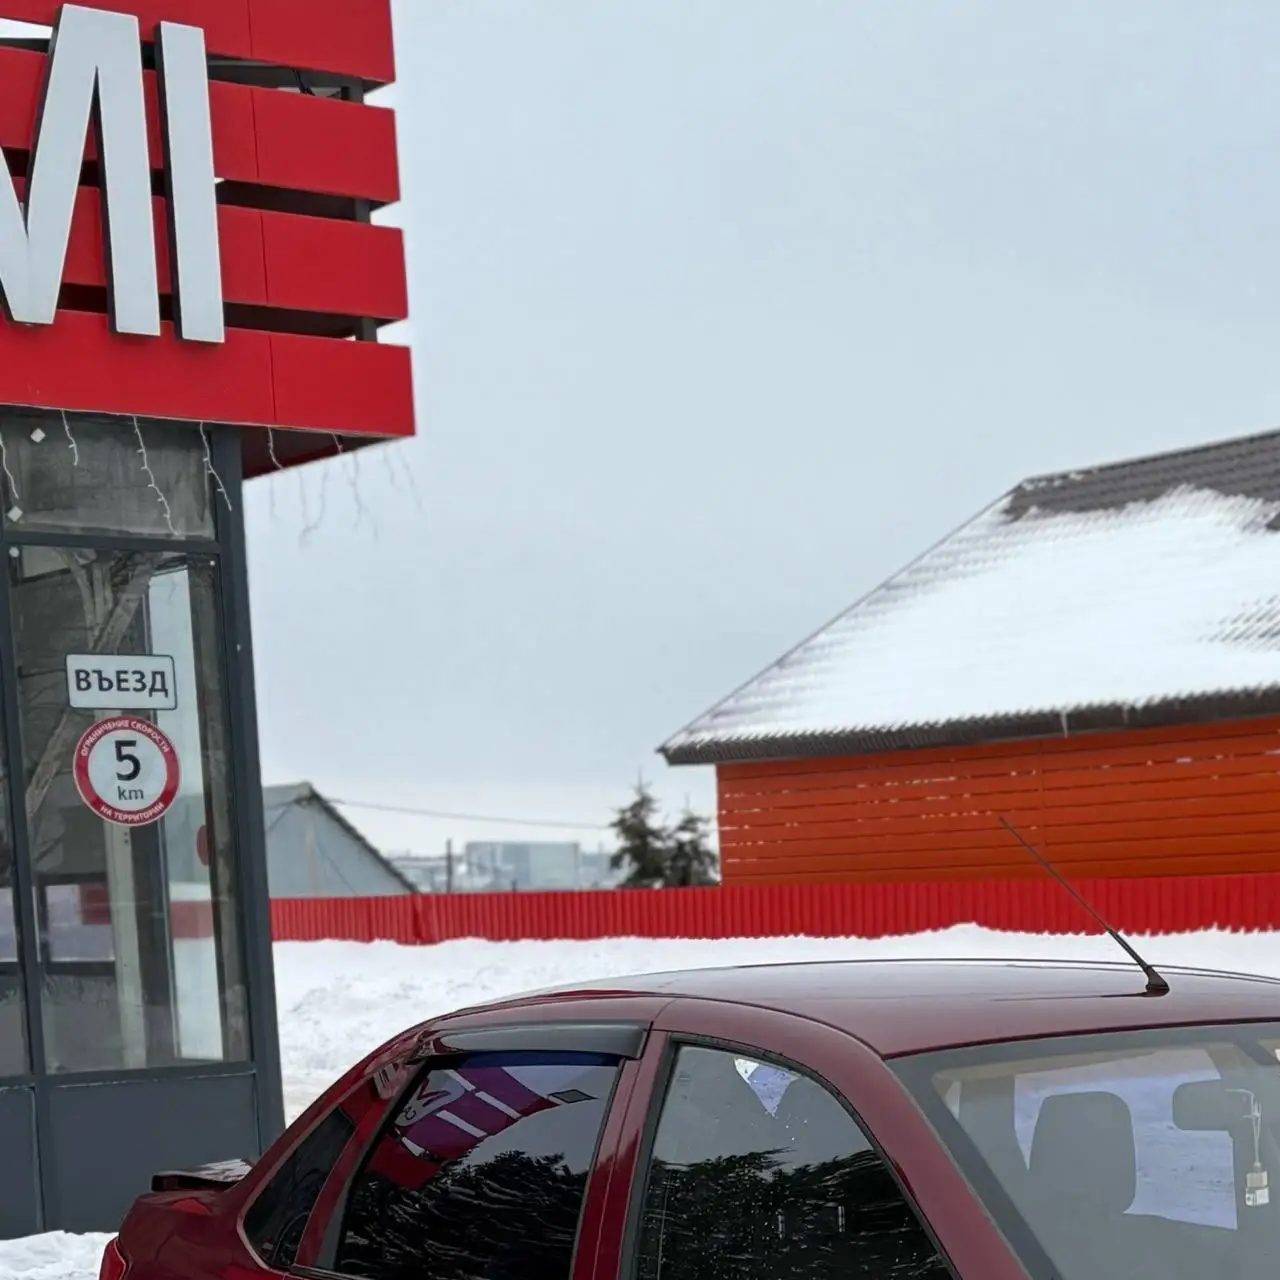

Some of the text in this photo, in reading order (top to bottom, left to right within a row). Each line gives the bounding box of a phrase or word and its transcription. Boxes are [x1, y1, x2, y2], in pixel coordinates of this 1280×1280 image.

[75, 669, 168, 698] ВЪЕЗД
[80, 719, 170, 757] ОГРАНИЧЕНИЕ СКОРОСТИ
[114, 740, 141, 781] 5
[117, 786, 144, 801] km
[100, 802, 165, 822] НА ТЕРРИТОРИИ
